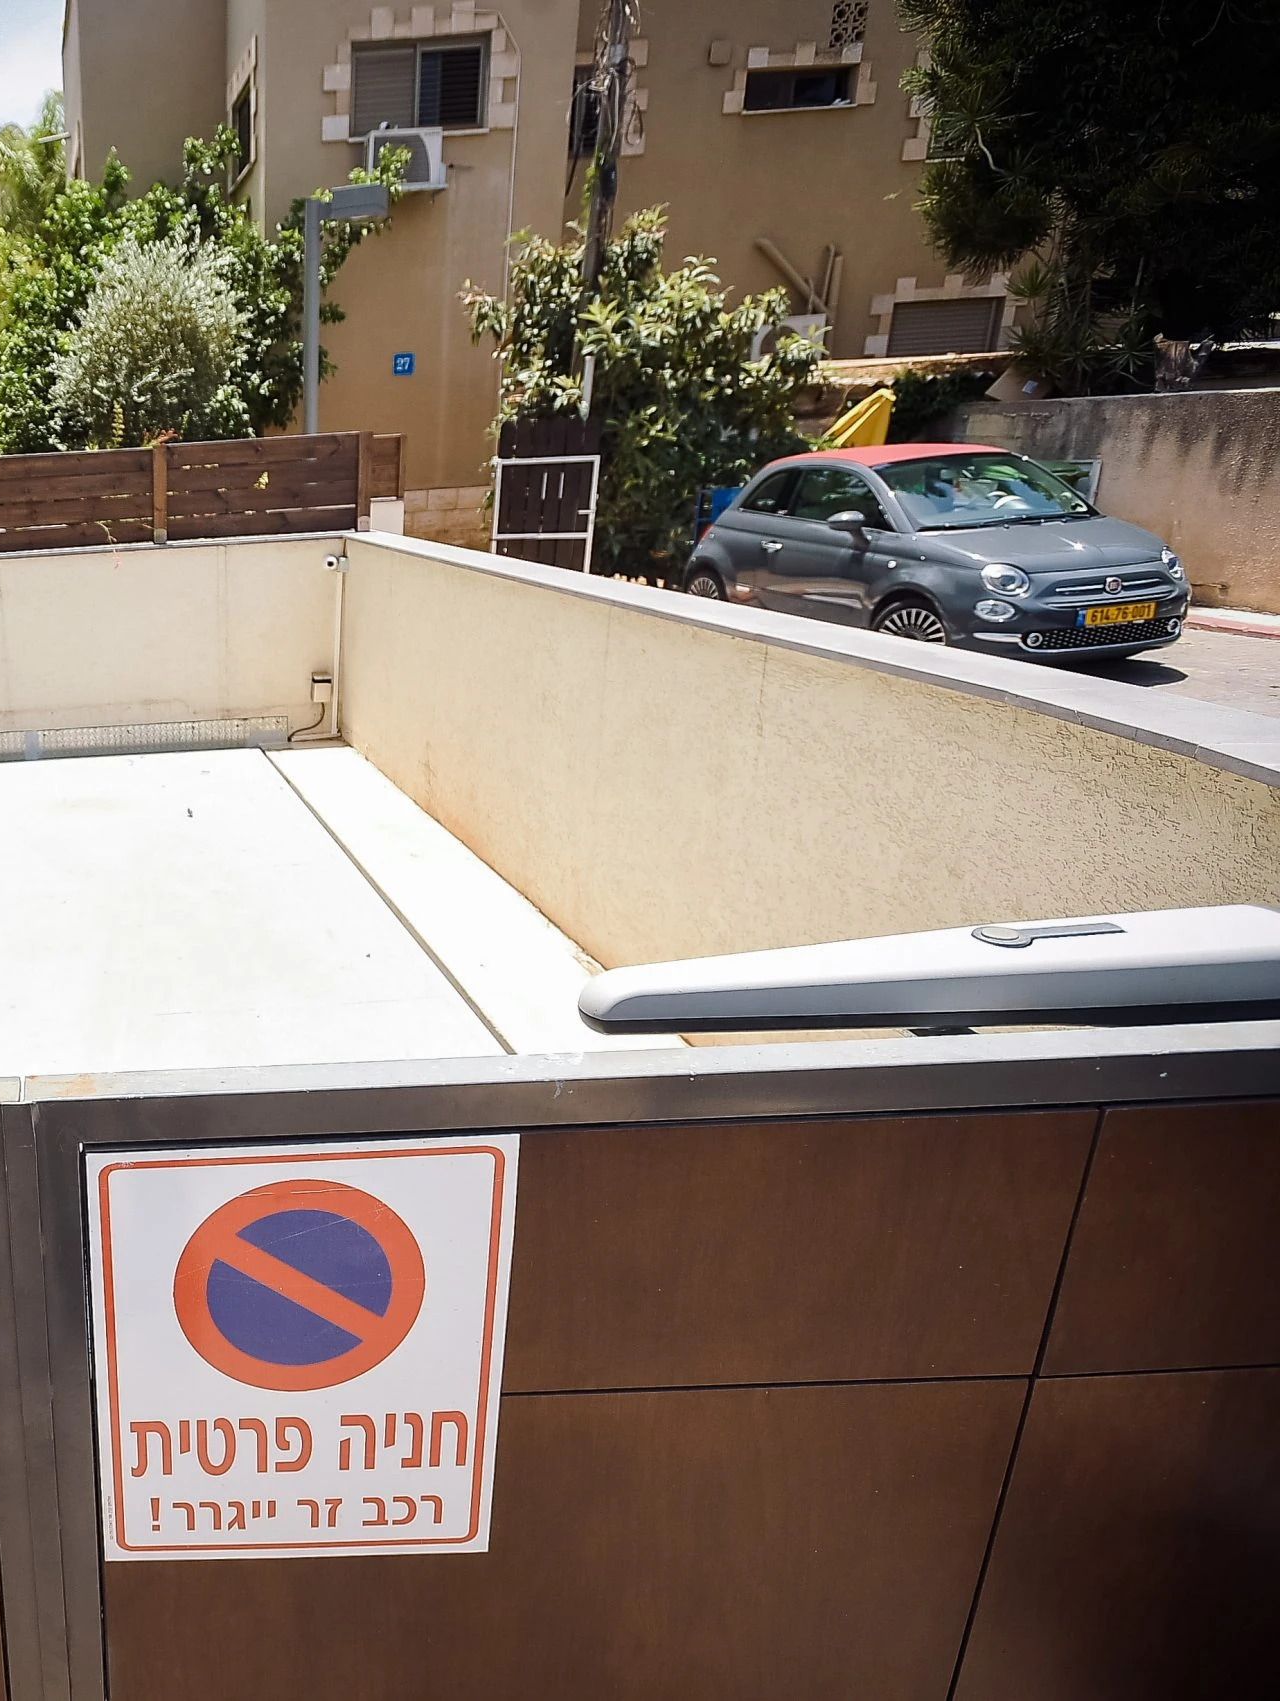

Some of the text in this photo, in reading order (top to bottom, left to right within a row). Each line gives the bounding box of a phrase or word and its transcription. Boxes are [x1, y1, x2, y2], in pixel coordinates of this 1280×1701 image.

[129, 1410, 469, 1478] חניה פרטית
[297, 1497, 343, 1529] זר
[361, 1494, 444, 1527] רכב
